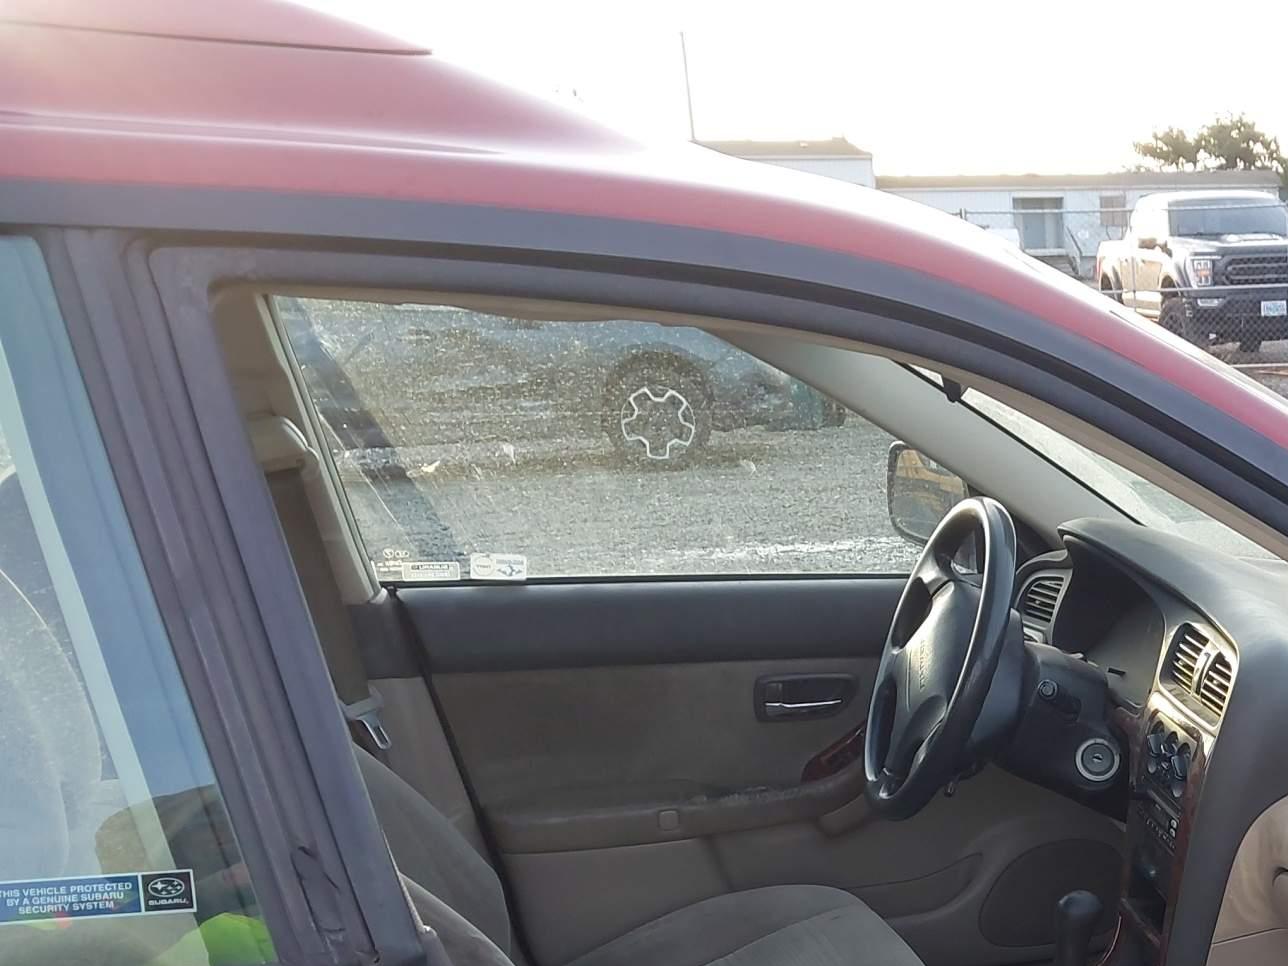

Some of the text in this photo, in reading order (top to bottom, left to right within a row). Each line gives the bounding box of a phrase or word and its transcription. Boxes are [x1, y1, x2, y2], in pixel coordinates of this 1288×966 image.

[23, 887, 66, 896] VEHICLE
[71, 883, 131, 893] PROTECTED
[22, 897, 30, 906] A
[32, 894, 78, 905] GENUINE
[80, 892, 124, 902] SUBARU
[148, 898, 187, 907] SUBARU
[18, 901, 114, 915] SECURITY SYSTEM
